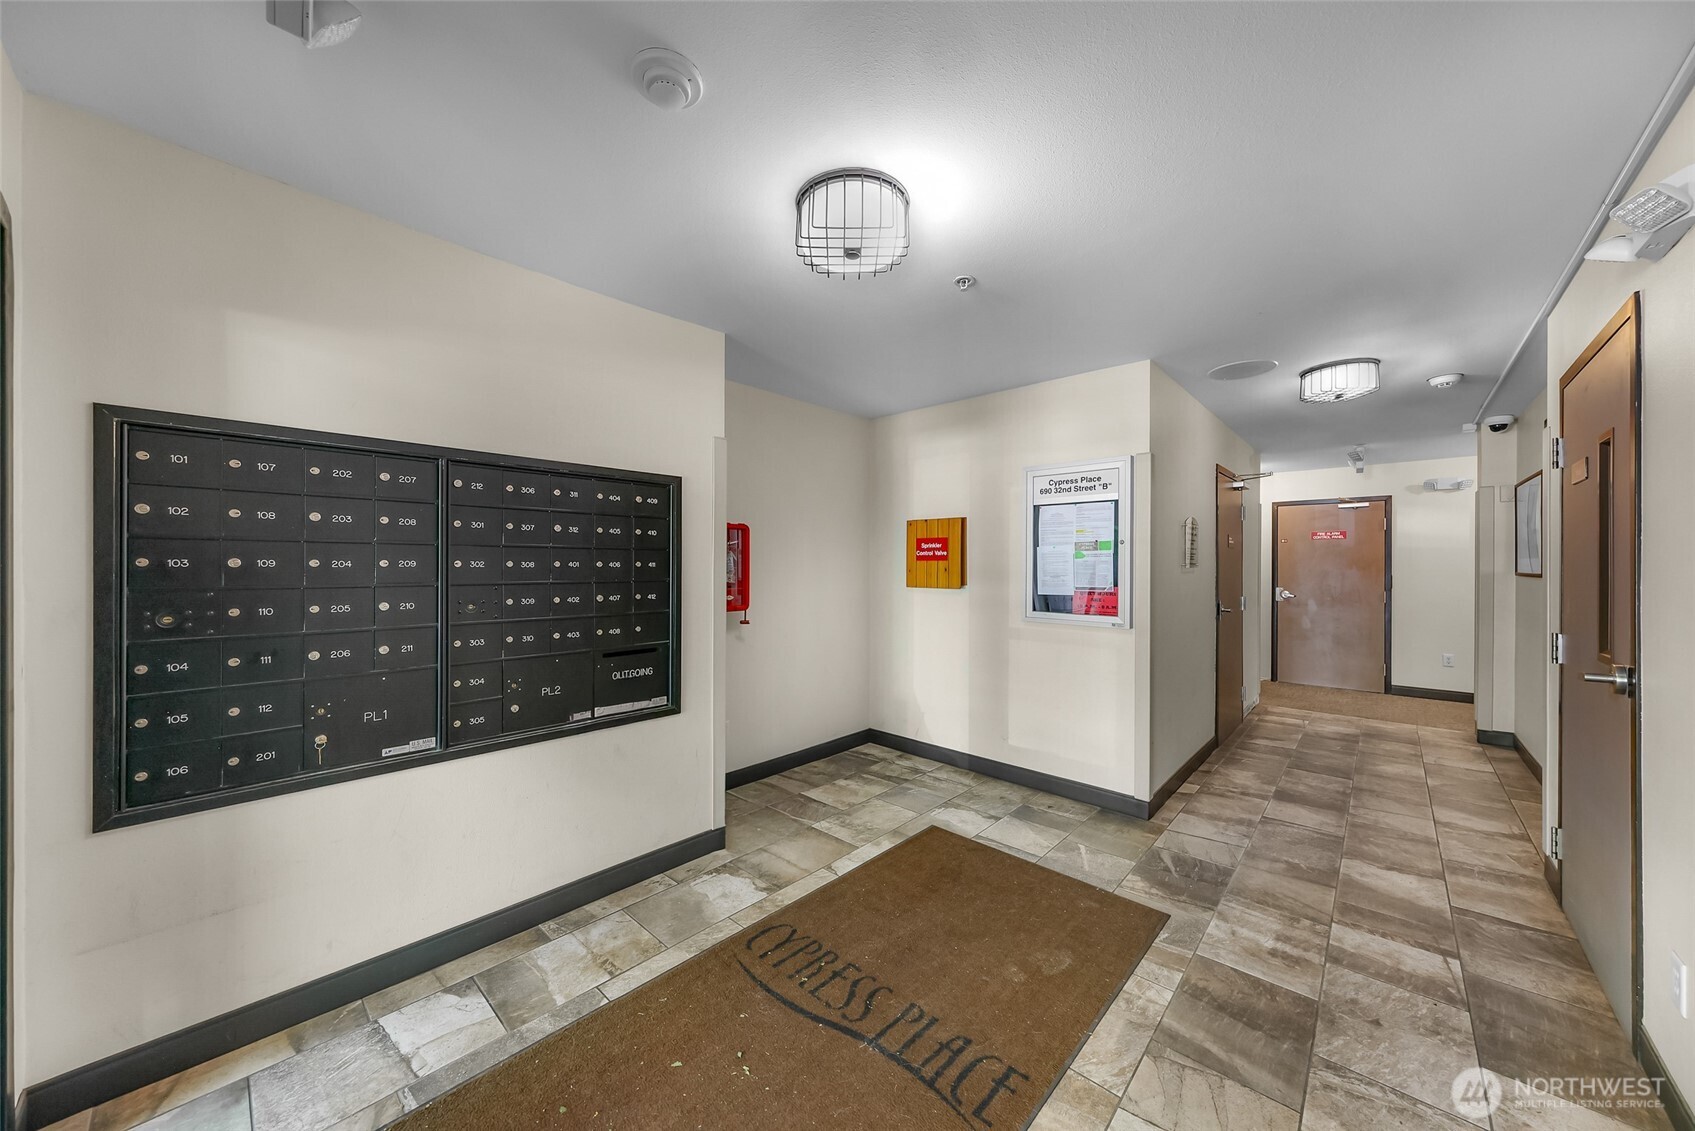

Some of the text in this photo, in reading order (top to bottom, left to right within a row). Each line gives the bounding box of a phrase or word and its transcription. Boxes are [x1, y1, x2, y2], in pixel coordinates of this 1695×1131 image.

[170, 454, 188, 464] 101
[257, 462, 277, 472] 107
[332, 469, 353, 479] 202
[398, 475, 417, 484] 207
[1048, 476, 1102, 487] Cypress Place
[470, 482, 484, 490] 212
[520, 486, 536, 495] 306
[1053, 486, 1072, 494] 32nd
[1073, 484, 1096, 492] Street
[1098, 482, 1112, 490] "B"
[608, 494, 621, 502] 404
[646, 497, 658, 505] 409
[167, 506, 190, 516] 102
[256, 511, 276, 520] 108
[332, 514, 353, 523] 203
[398, 517, 417, 526] 208
[470, 521, 485, 529] 301
[520, 523, 535, 531] 307
[568, 526, 579, 534] 312
[167, 558, 190, 568] 103
[256, 559, 276, 568] 109
[331, 559, 352, 568] 204
[398, 559, 417, 568] 209
[469, 560, 485, 568] 302
[520, 597, 536, 605] 309
[608, 594, 621, 602] 407
[330, 604, 351, 613] 205
[399, 602, 415, 610] 210
[258, 607, 274, 616] 110
[521, 634, 535, 643] 310
[566, 631, 581, 639] 403
[469, 638, 485, 647] 303
[401, 644, 414, 653] 211
[330, 649, 351, 659] 206
[260, 655, 272, 665] 111
[166, 662, 189, 672] 104
[612, 667, 653, 680] OUTGOING
[468, 677, 485, 686] 304
[541, 685, 562, 697] PL2
[258, 703, 273, 713] 112
[166, 713, 189, 725] 105
[363, 709, 388, 723] PL1
[469, 716, 486, 726] 305
[255, 750, 276, 762] 201
[166, 765, 189, 777] 106
[745, 923, 1030, 1128] CYPRESS PLACE
